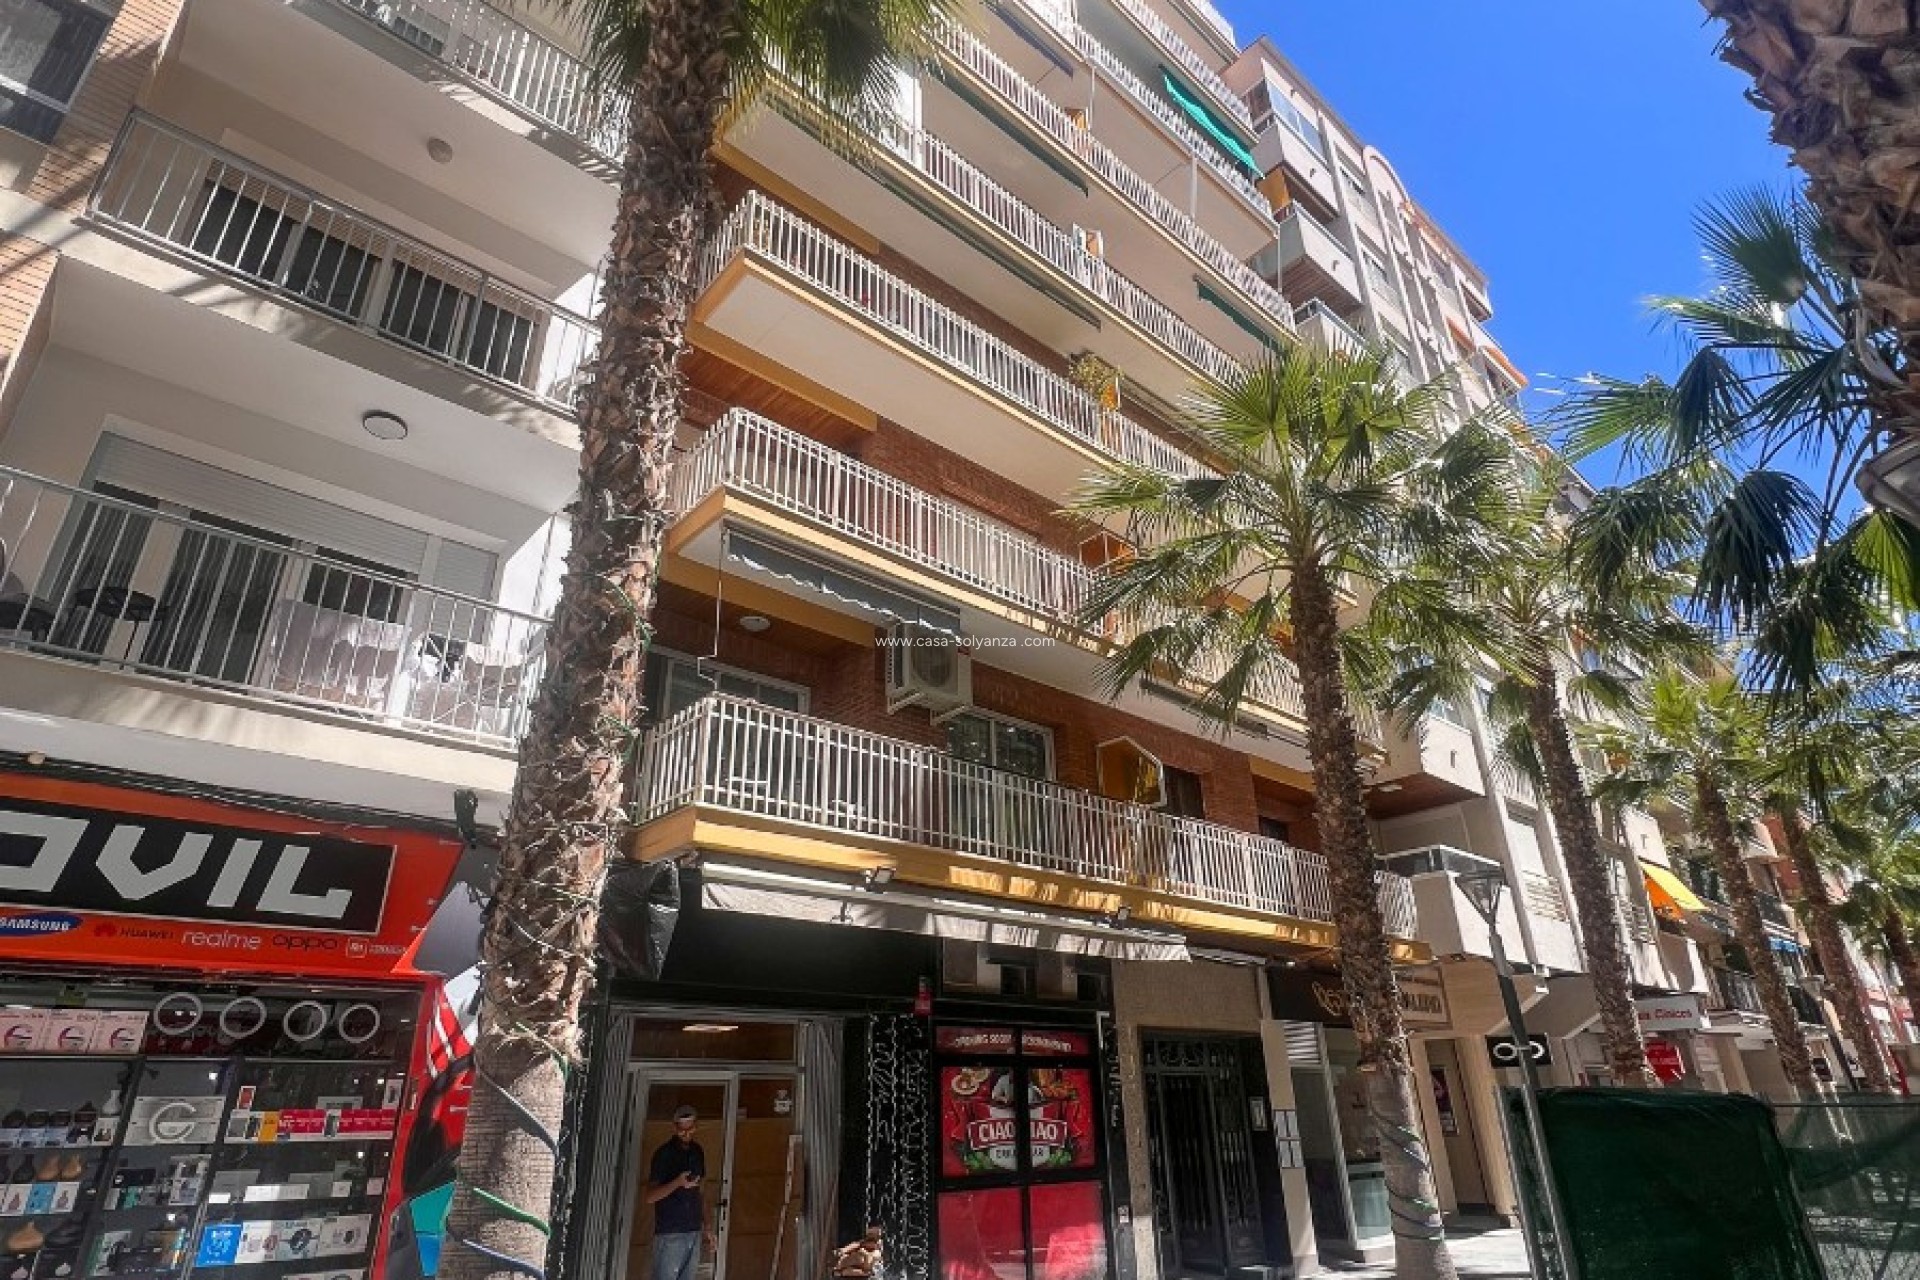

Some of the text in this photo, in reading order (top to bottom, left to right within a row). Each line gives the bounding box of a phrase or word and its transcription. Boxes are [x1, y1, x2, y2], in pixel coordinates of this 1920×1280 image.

[181, 929, 262, 950] realme
[272, 933, 338, 951] oppo
[978, 1121, 1059, 1142] CIAO IAO
